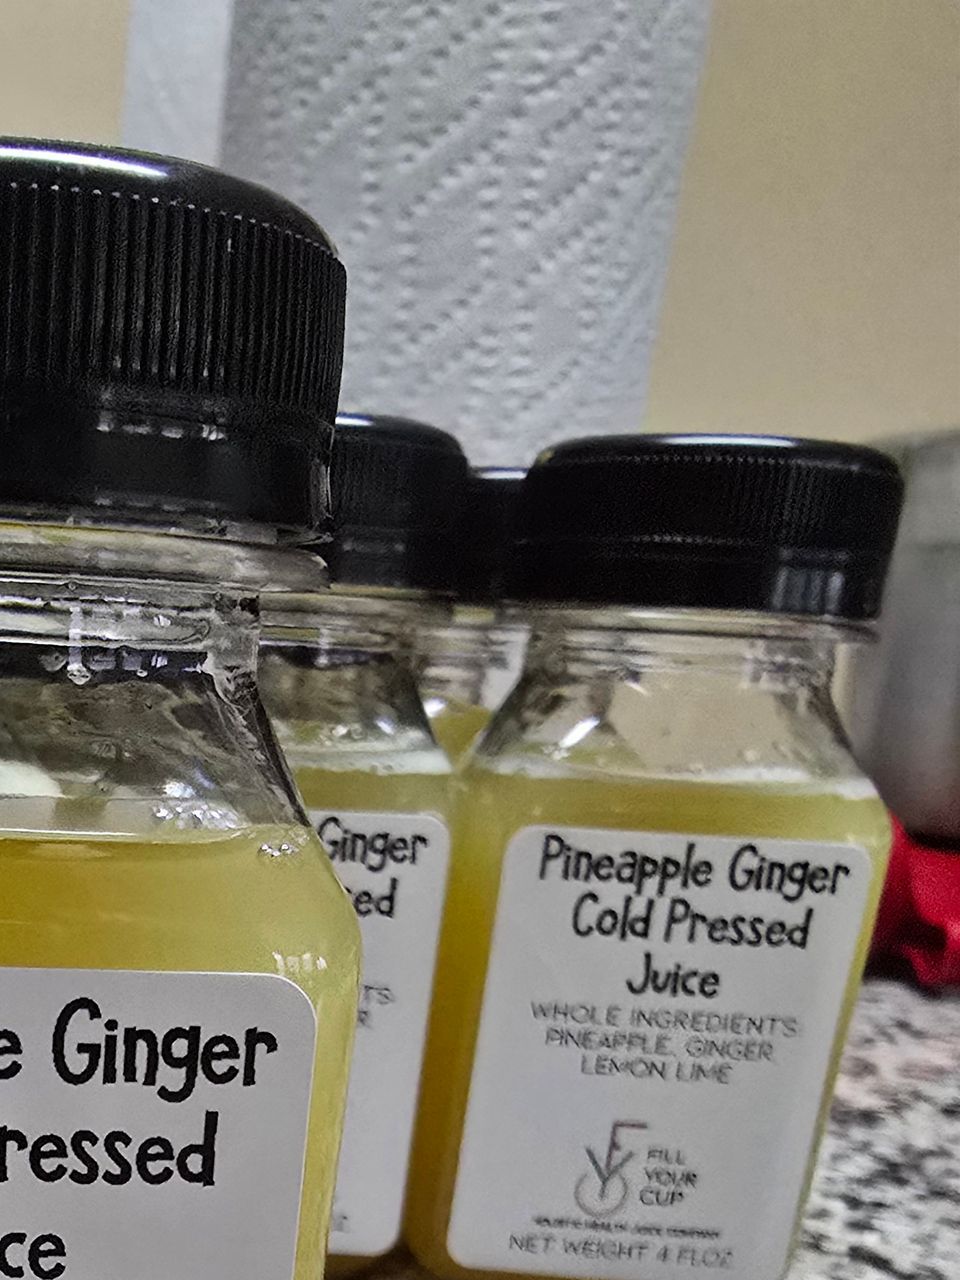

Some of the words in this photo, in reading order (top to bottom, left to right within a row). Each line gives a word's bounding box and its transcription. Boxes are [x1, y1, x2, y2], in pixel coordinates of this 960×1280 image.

[318, 816, 429, 873] Ginger
[540, 834, 713, 896] Pineapple
[728, 843, 849, 902] Ginger
[572, 892, 654, 941] Cold
[663, 898, 813, 950] Pressed
[626, 952, 720, 998] Juice
[531, 1001, 622, 1026] WHOLE
[52, 997, 278, 1103] Ginger
[675, 1060, 734, 1085] LIME
[640, 1187, 684, 1206] CUP
